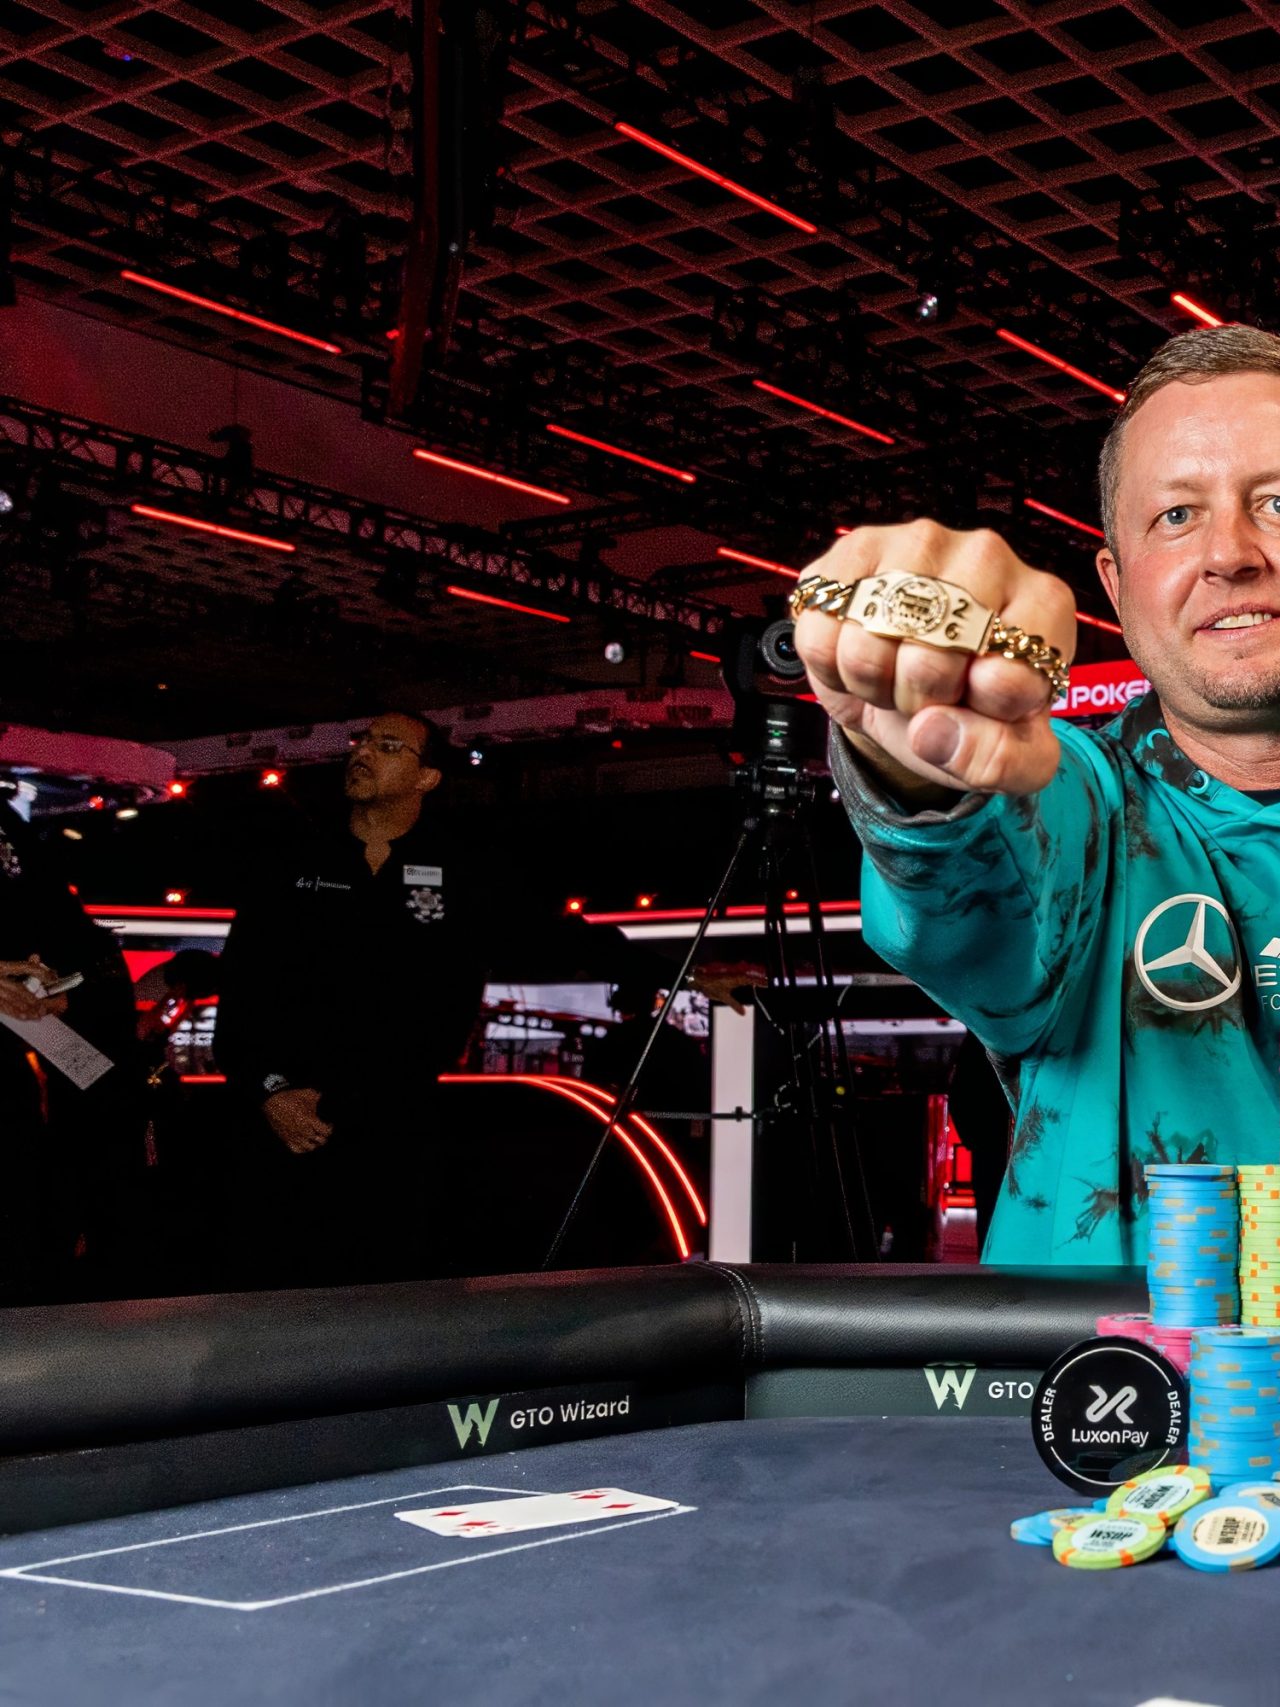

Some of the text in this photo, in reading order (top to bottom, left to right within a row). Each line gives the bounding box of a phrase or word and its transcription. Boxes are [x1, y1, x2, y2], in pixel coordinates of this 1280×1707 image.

[952, 599, 970, 619] 2
[988, 1382, 1035, 1399] GTO
[510, 1395, 630, 1430] GTO Wizard
[1041, 1387, 1057, 1442] DEALER
[1165, 1390, 1182, 1445] DEALER
[1071, 1428, 1149, 1448] LuxonPay
